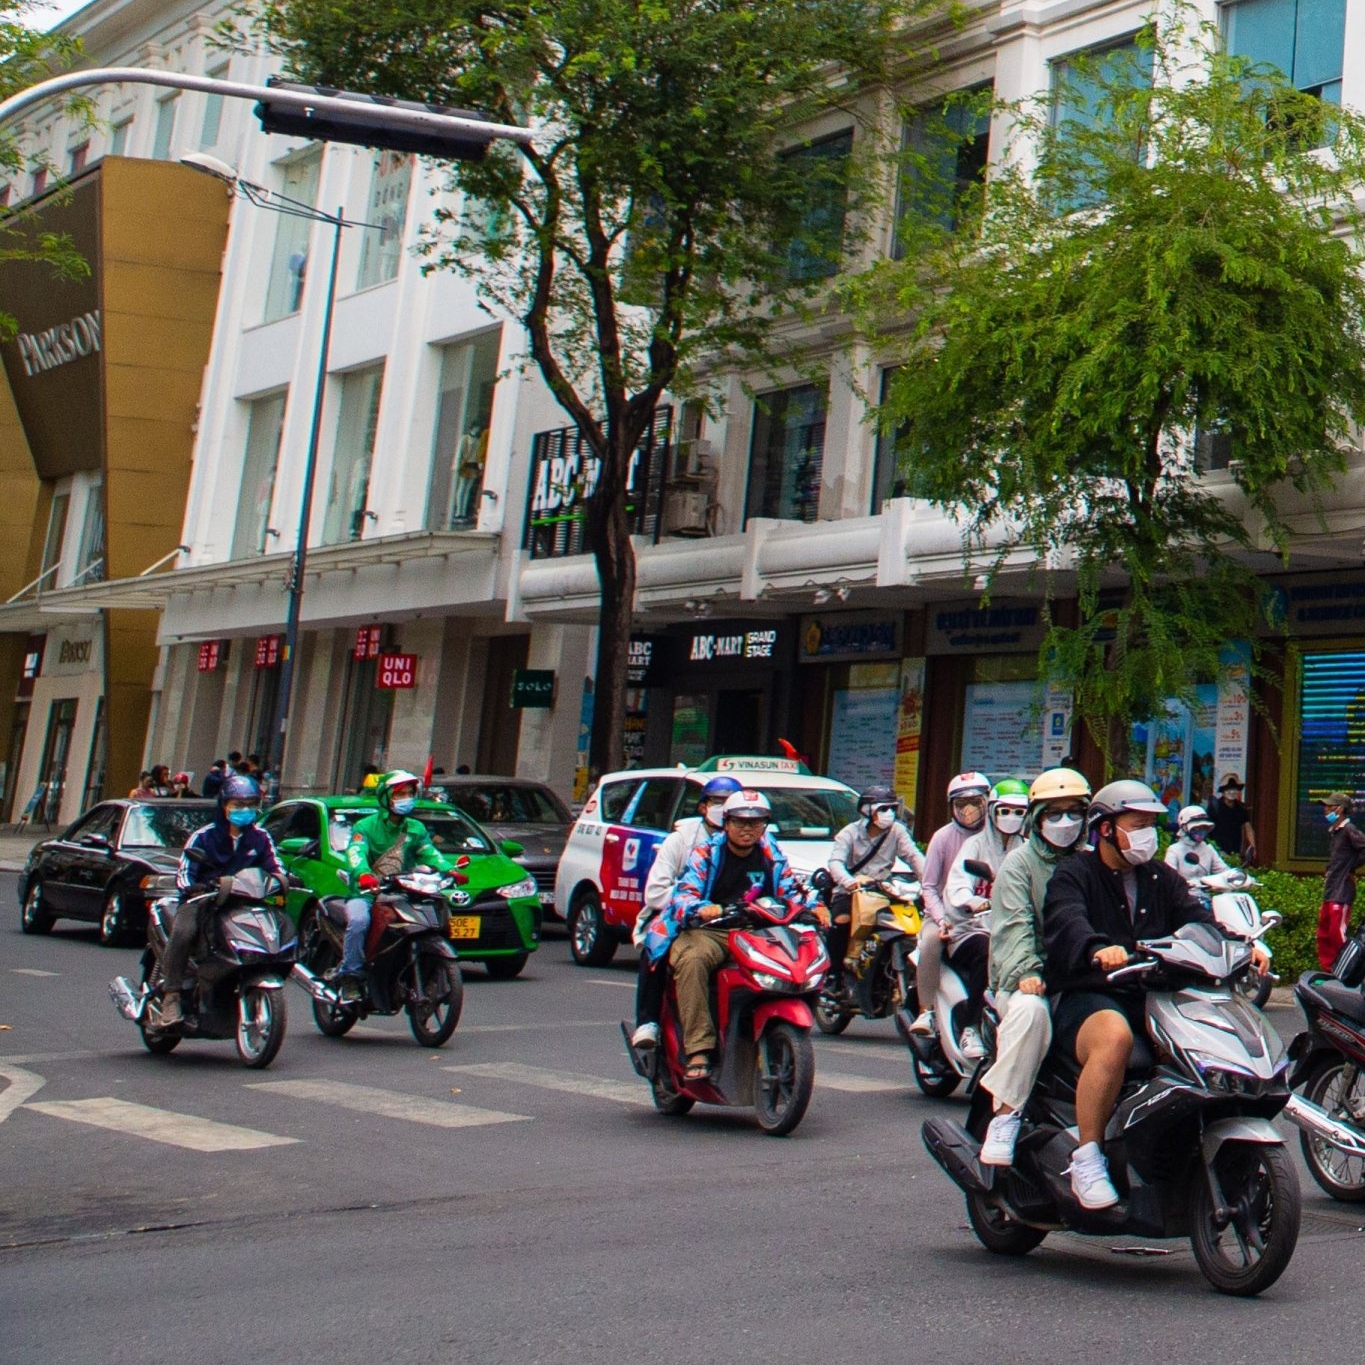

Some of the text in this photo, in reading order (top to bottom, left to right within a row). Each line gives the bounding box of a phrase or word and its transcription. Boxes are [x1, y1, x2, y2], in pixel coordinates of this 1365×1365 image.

[747, 630, 777, 644] GRAND
[689, 635, 744, 661] ABC-MART
[746, 644, 773, 658] STAGE
[383, 657, 411, 670] UNI
[382, 671, 412, 685] QLO
[517, 681, 552, 692] SOLO
[738, 760, 797, 770] VINASUN TAX
